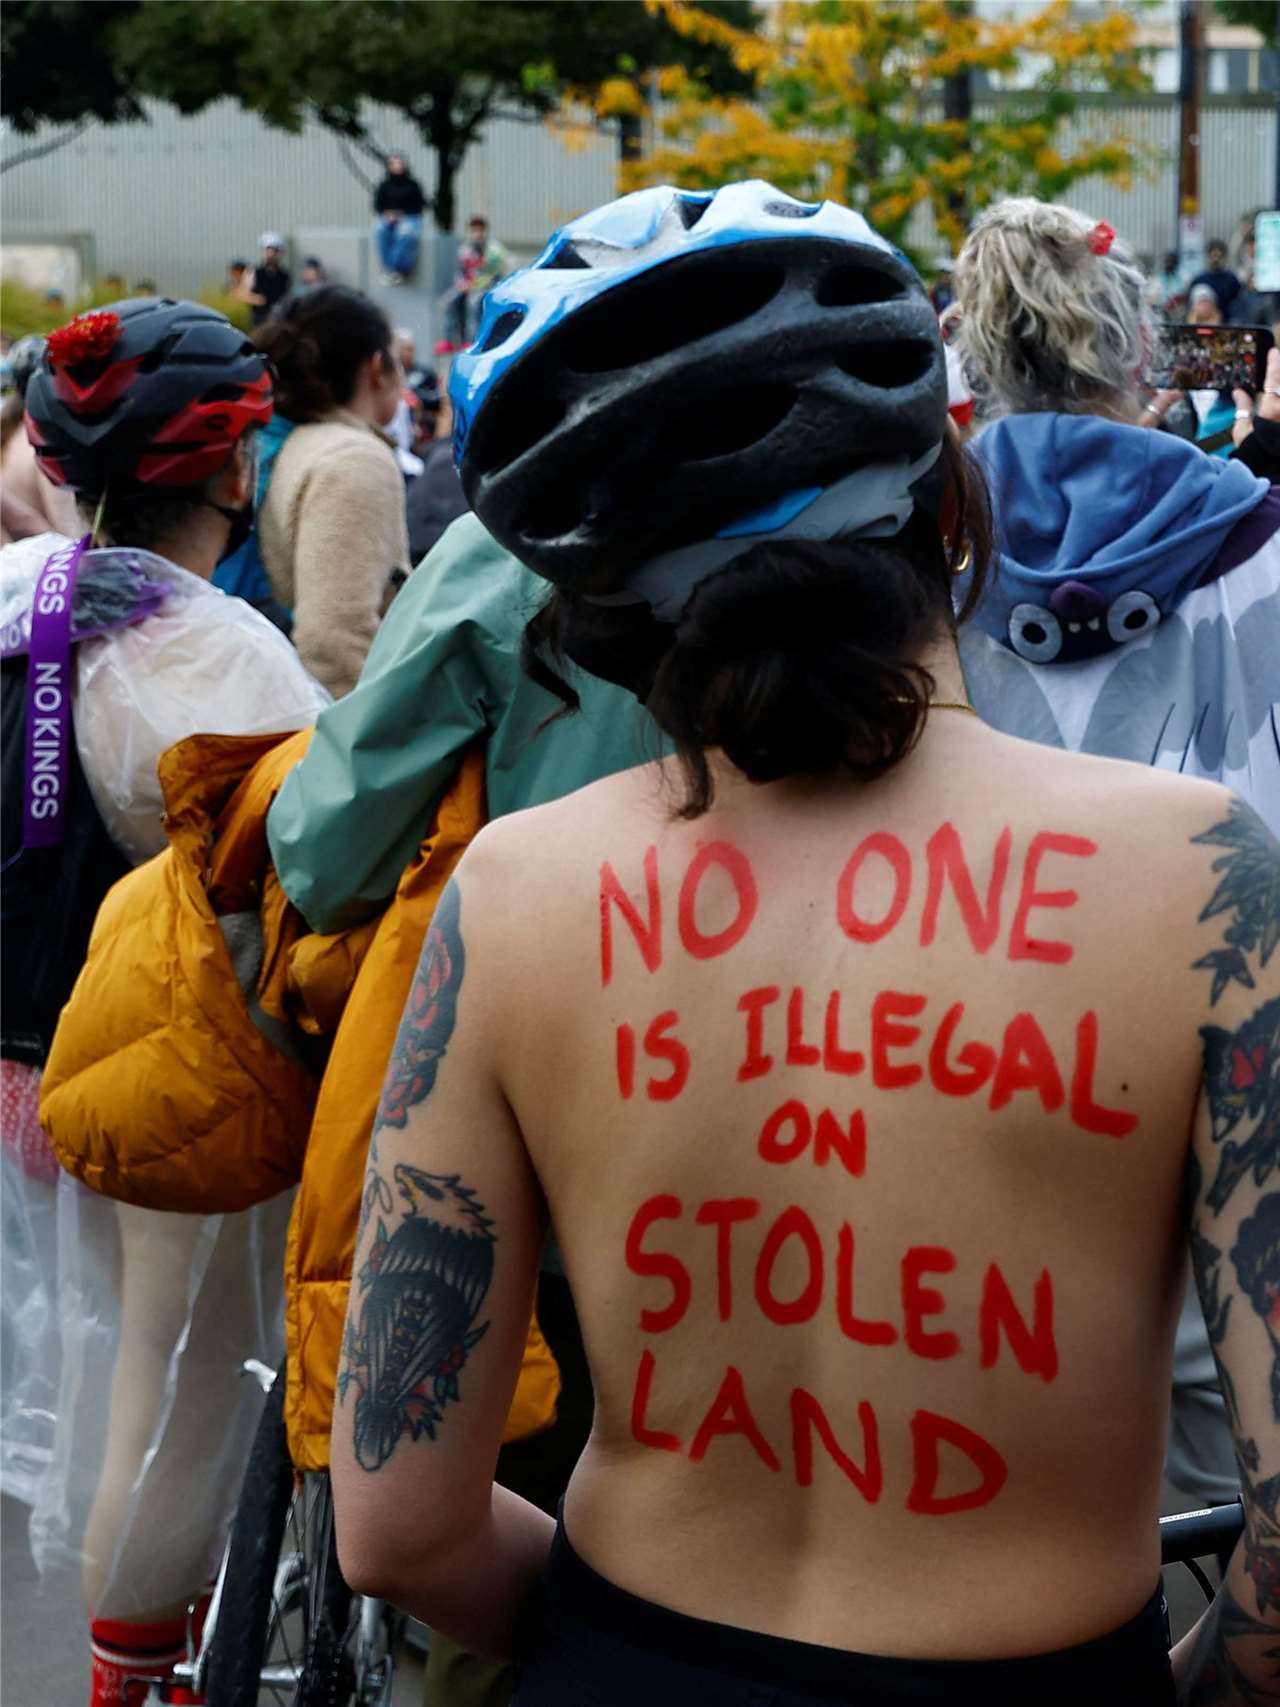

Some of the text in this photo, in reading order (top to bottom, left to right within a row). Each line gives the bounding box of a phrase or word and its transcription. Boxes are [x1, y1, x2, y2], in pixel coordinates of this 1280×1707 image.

[30, 661, 62, 820] NO KINGS
[599, 821, 1098, 987] NO ONE
[615, 984, 1139, 1138] IS ILLEGAL
[757, 1098, 869, 1179] ON
[624, 1193, 1060, 1383] STOLEN
[631, 1348, 1009, 1516] LAND
